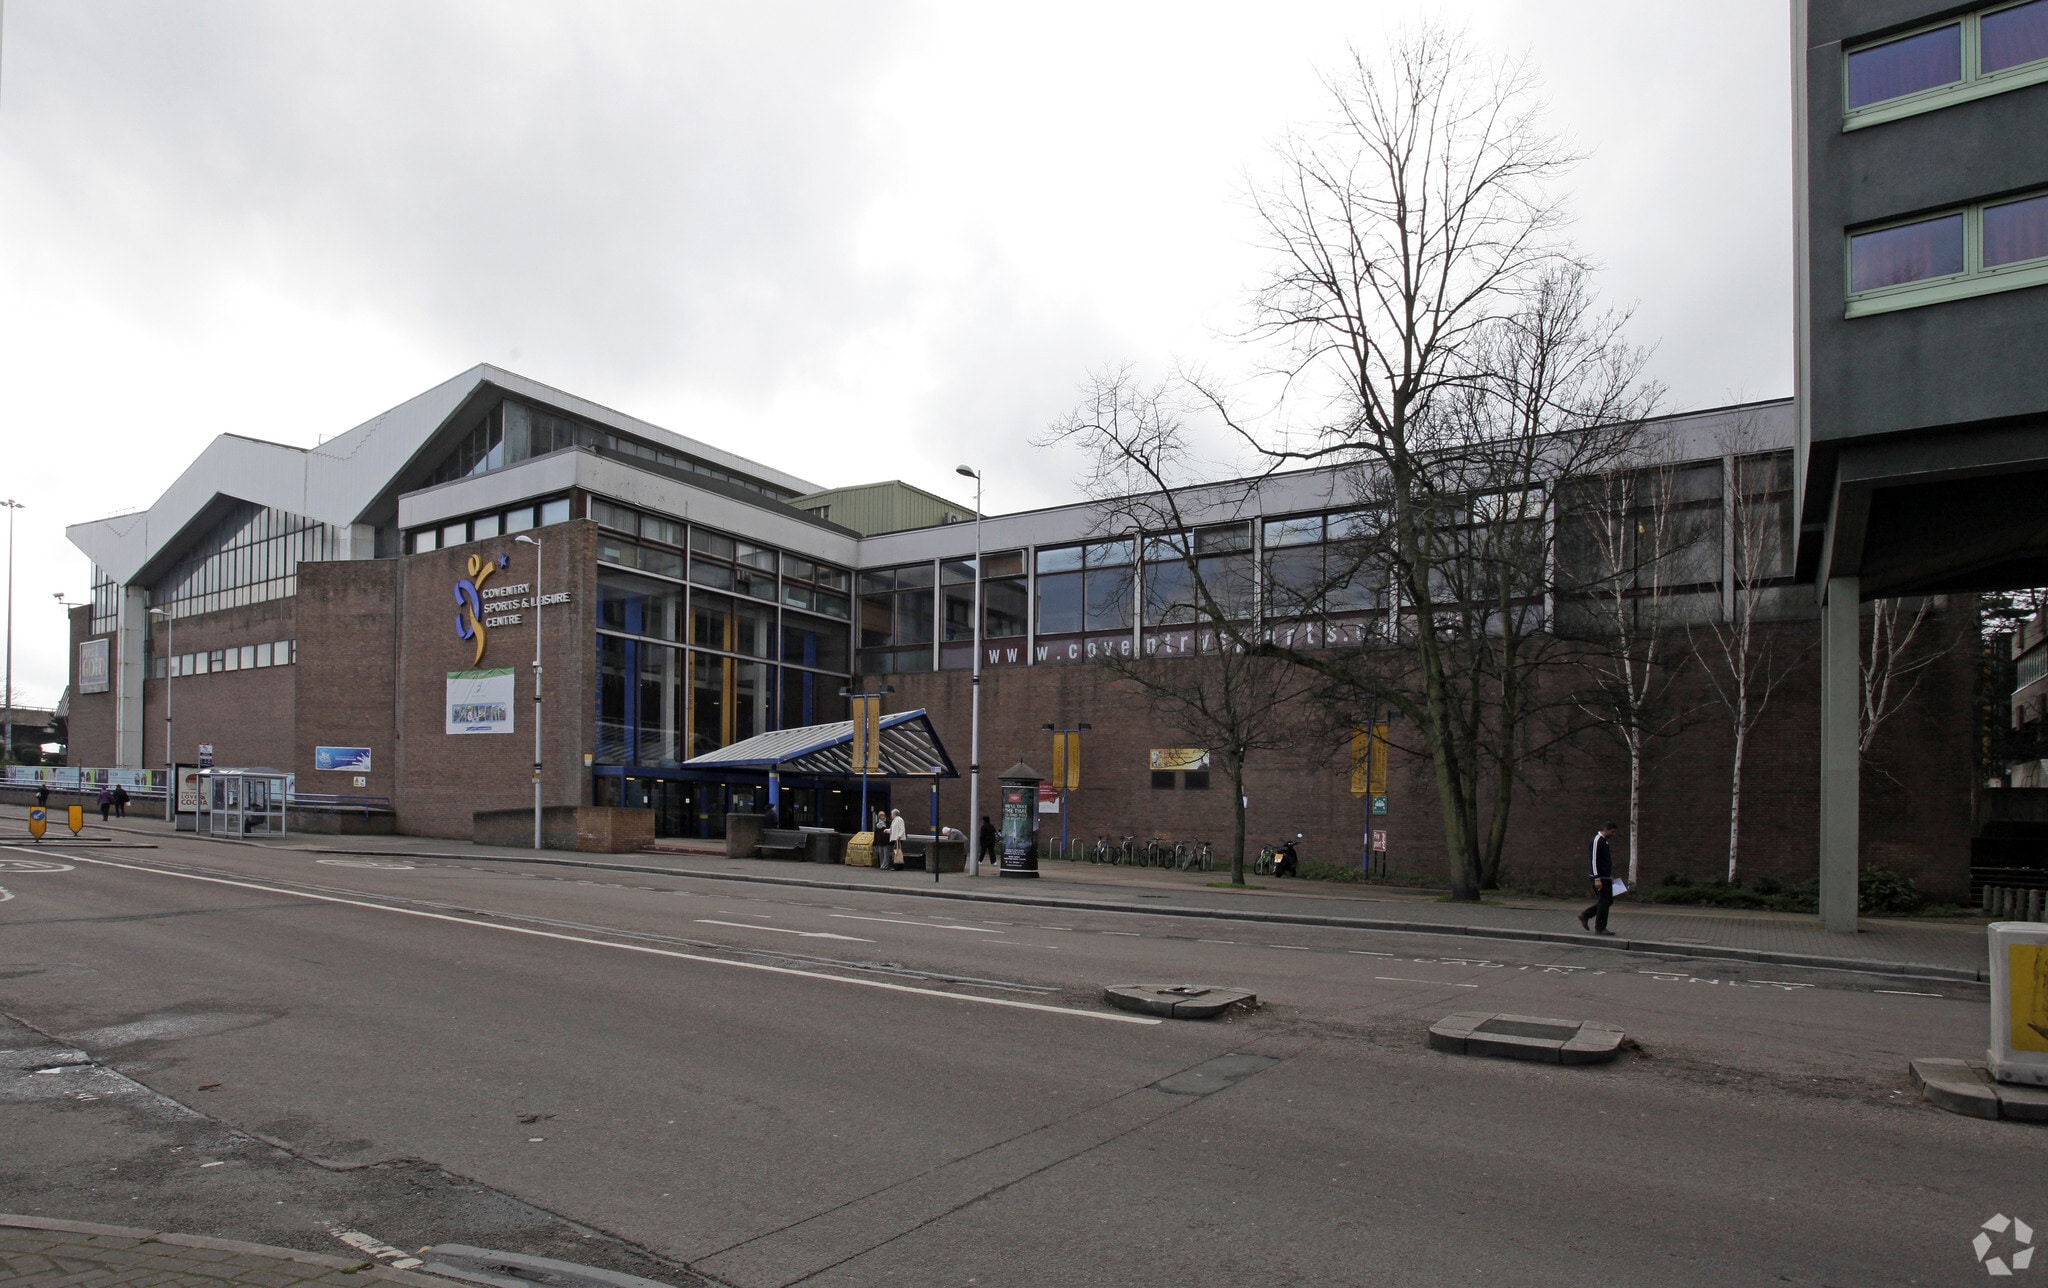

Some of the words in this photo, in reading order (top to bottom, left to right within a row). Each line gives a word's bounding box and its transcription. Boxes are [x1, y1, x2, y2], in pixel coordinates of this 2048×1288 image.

[482, 583, 531, 599] COVENTRY
[484, 599, 520, 613] SPORTS
[521, 597, 530, 608] &
[530, 592, 571, 607] LEISURE
[485, 614, 522, 627] CENTRE
